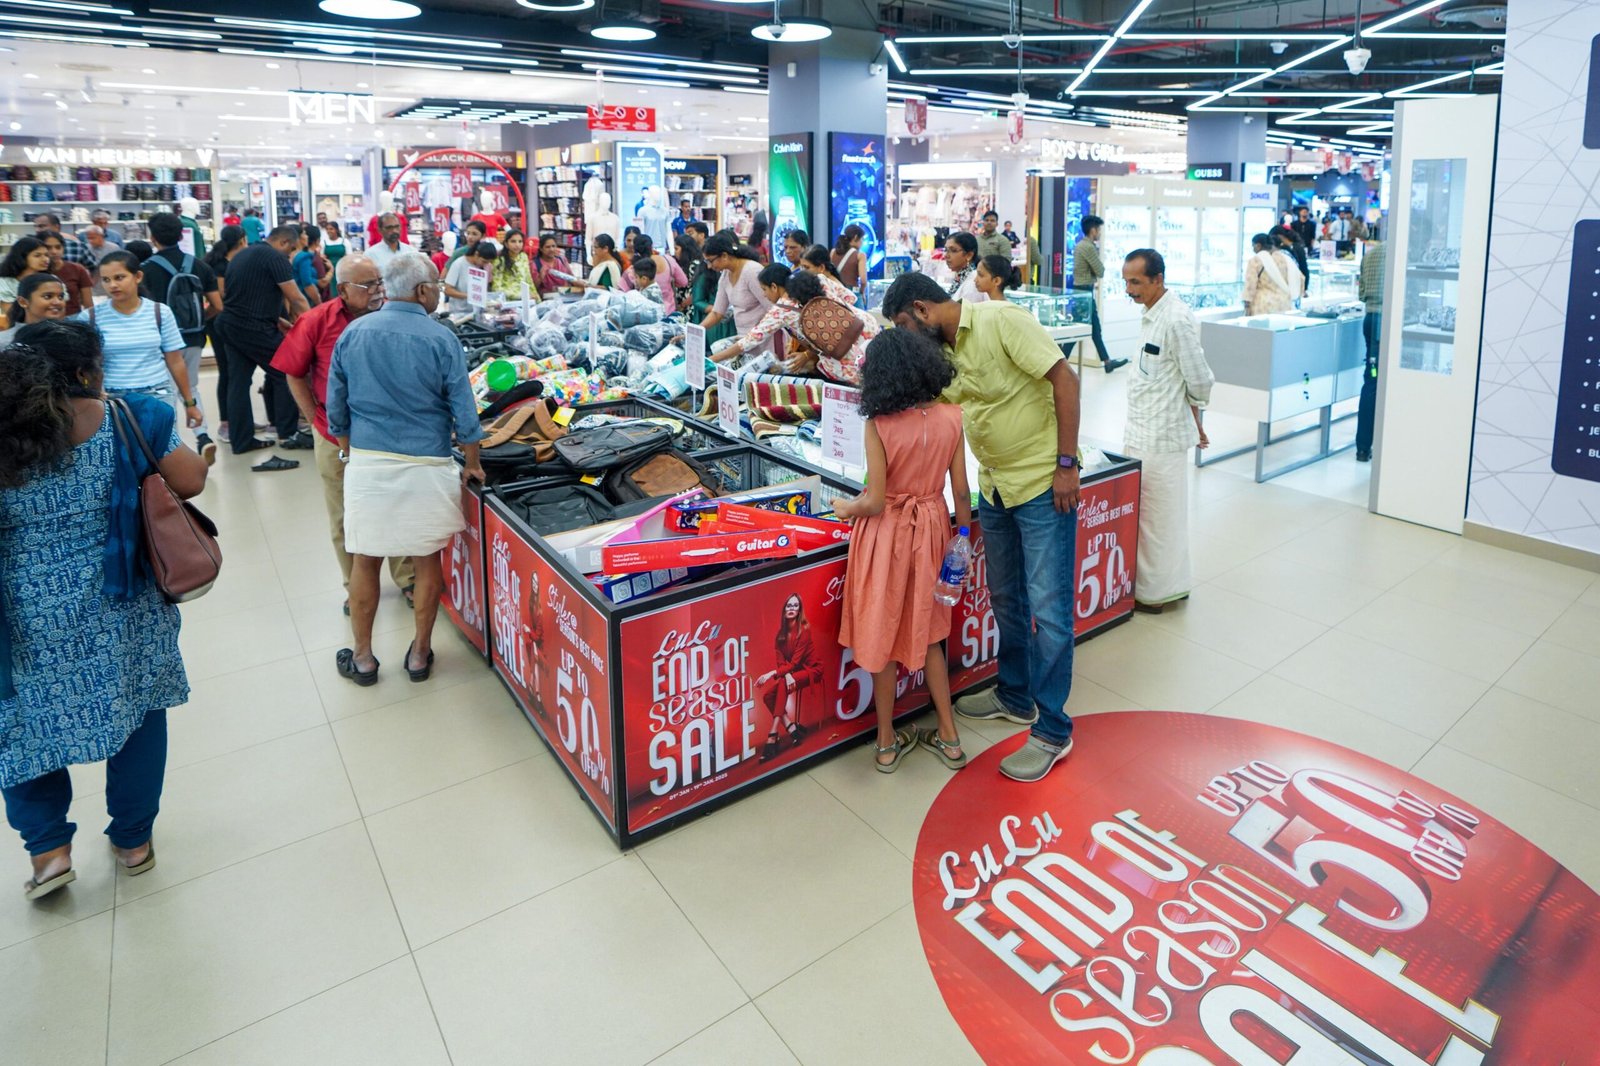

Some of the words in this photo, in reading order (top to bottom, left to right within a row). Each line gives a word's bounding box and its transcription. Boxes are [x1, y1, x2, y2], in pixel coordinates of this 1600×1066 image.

[288, 93, 375, 124] MEN
[24, 146, 79, 164] VAN
[81, 147, 182, 165] HEUSEN
[773, 143, 791, 154] Calvin
[1041, 138, 1075, 160] BOYS
[1078, 143, 1089, 160] &
[1090, 143, 1124, 163] GIRLS
[1194, 168, 1222, 178] GUESS
[720, 401, 735, 423] 60
[832, 529, 852, 540] Gui
[1109, 506, 1121, 521] BEST
[1121, 501, 1134, 516] PRICE
[736, 538, 776, 552] Guitar
[1088, 533, 1103, 556] UP
[1104, 532, 1117, 550] TO
[492, 546, 509, 592] END
[511, 570, 520, 605] OF
[494, 604, 527, 689] SALE
[652, 619, 723, 659] LuLu
[962, 608, 1000, 668] SA
[561, 648, 574, 675] UP
[575, 662, 588, 697] TO
[652, 644, 710, 703] END
[723, 635, 749, 677] OF
[649, 673, 753, 733] season
[649, 700, 756, 797] SALE
[1196, 775, 1251, 817] UP
[1229, 760, 1291, 790] TO
[938, 811, 1063, 911] LuLu
[1410, 828, 1467, 881] OFF
[953, 852, 1134, 995] END
[1091, 808, 1208, 883] OF
[1049, 864, 1296, 1065] season
[1137, 901, 1501, 1066] ALE
